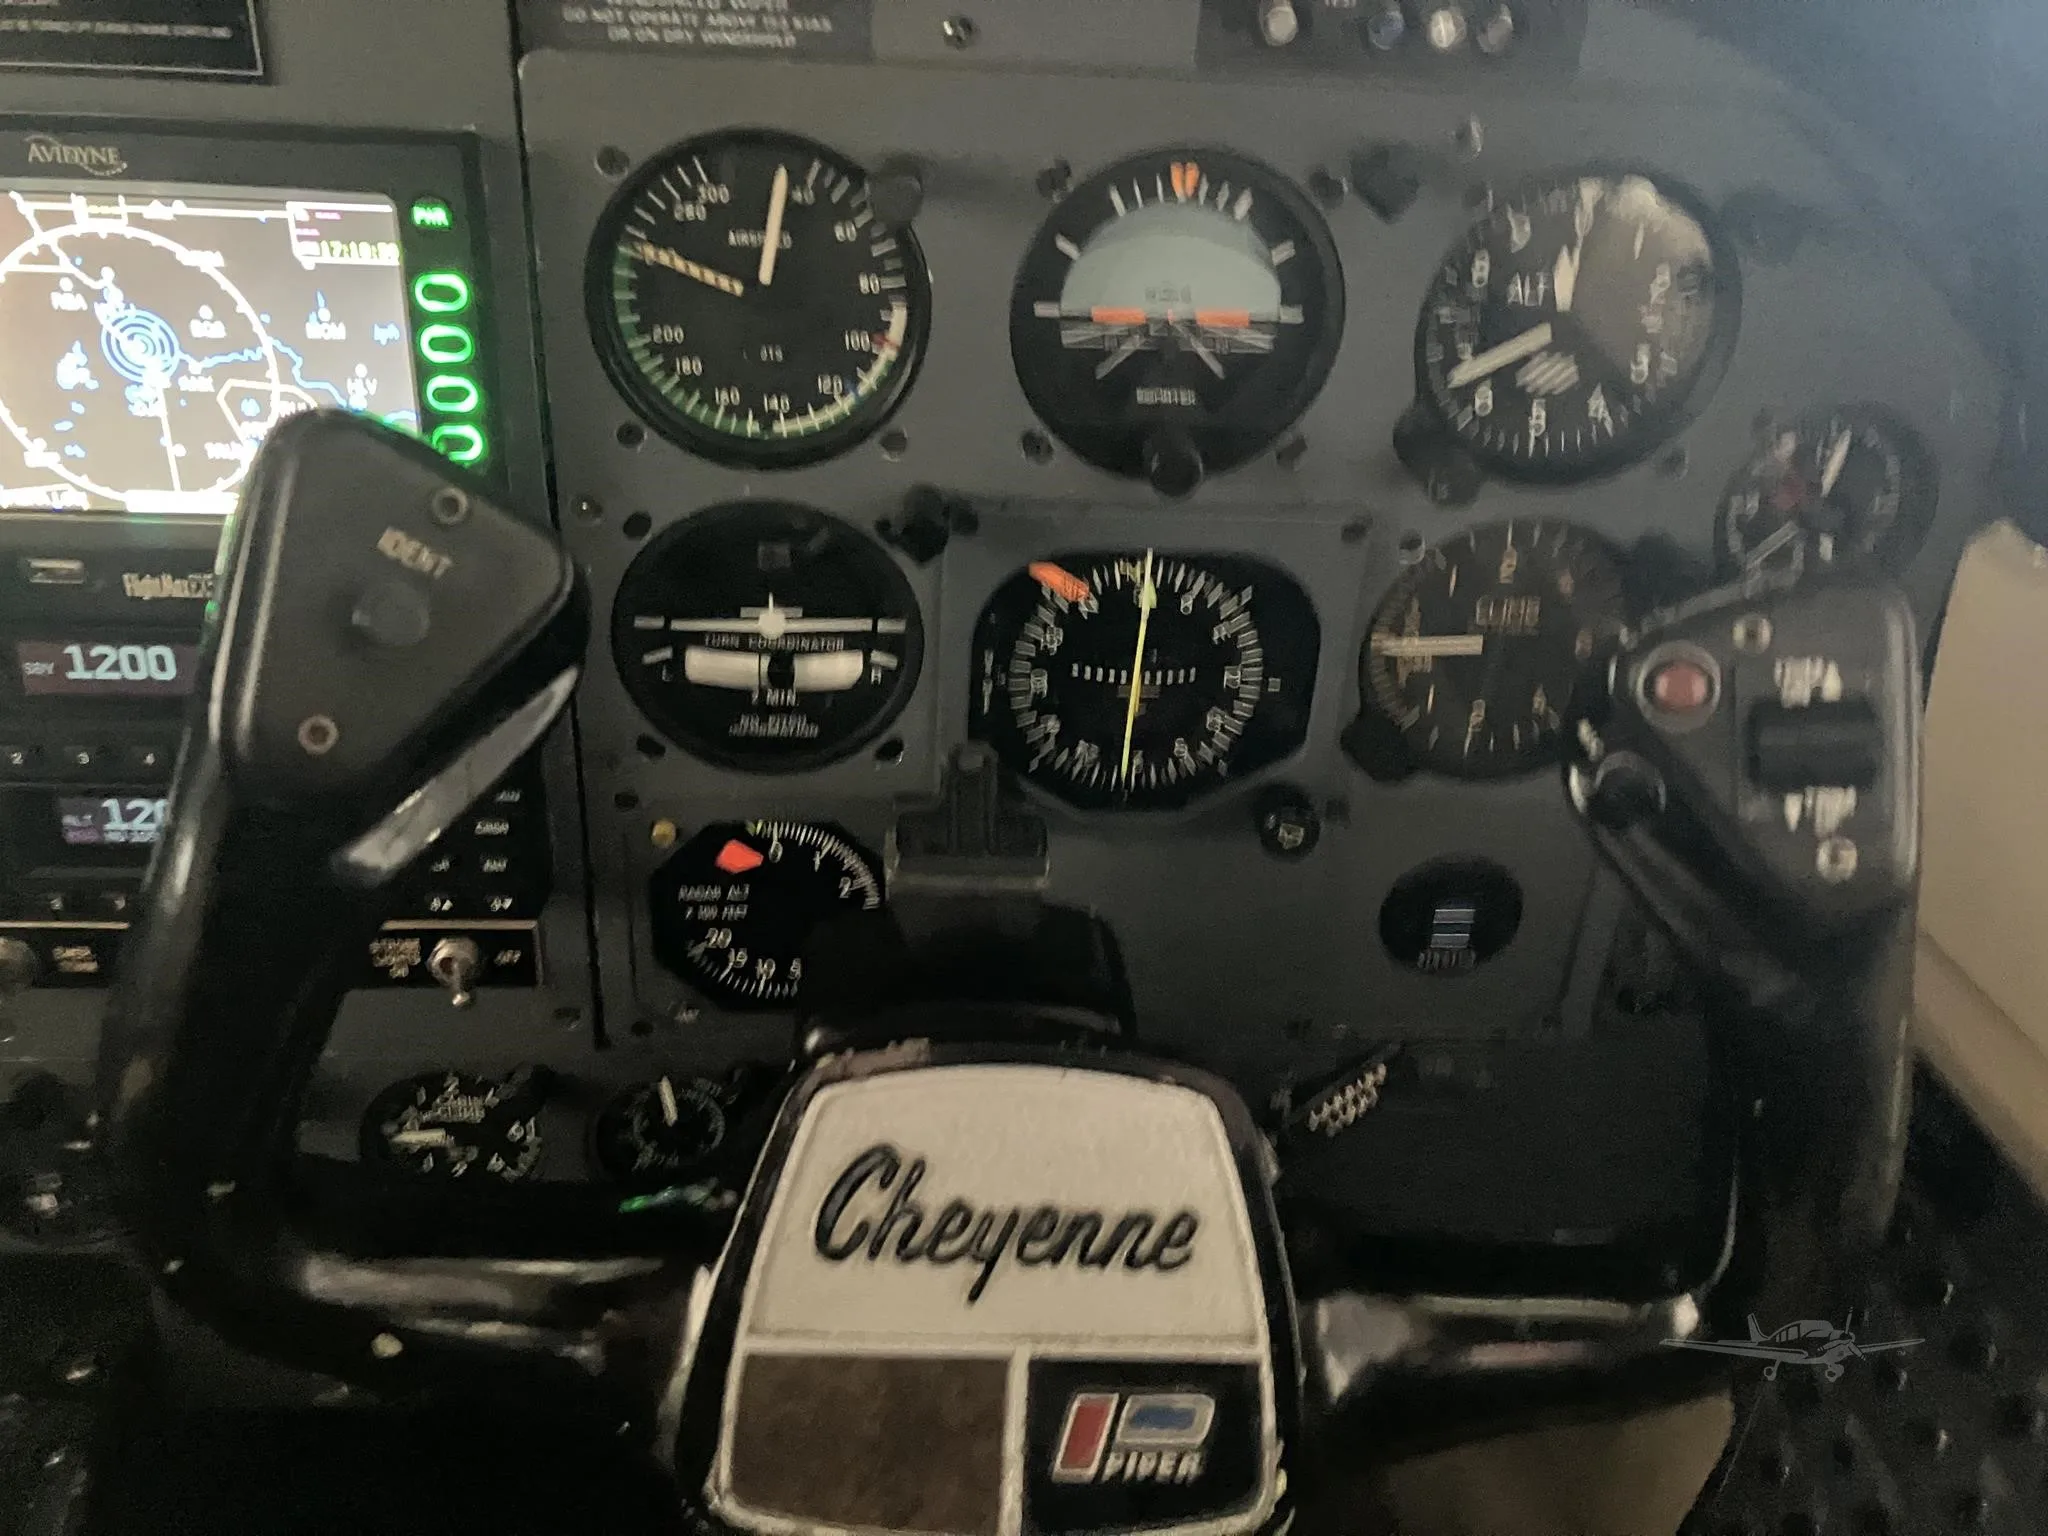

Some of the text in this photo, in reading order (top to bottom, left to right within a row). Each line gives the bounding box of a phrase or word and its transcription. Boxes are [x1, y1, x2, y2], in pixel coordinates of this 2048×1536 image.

[27, 141, 122, 166] AVIDYNE
[844, 329, 870, 352] 100
[63, 644, 177, 681] 1200
[704, 927, 733, 949] 20
[813, 1141, 1200, 1308] Cheyenne
